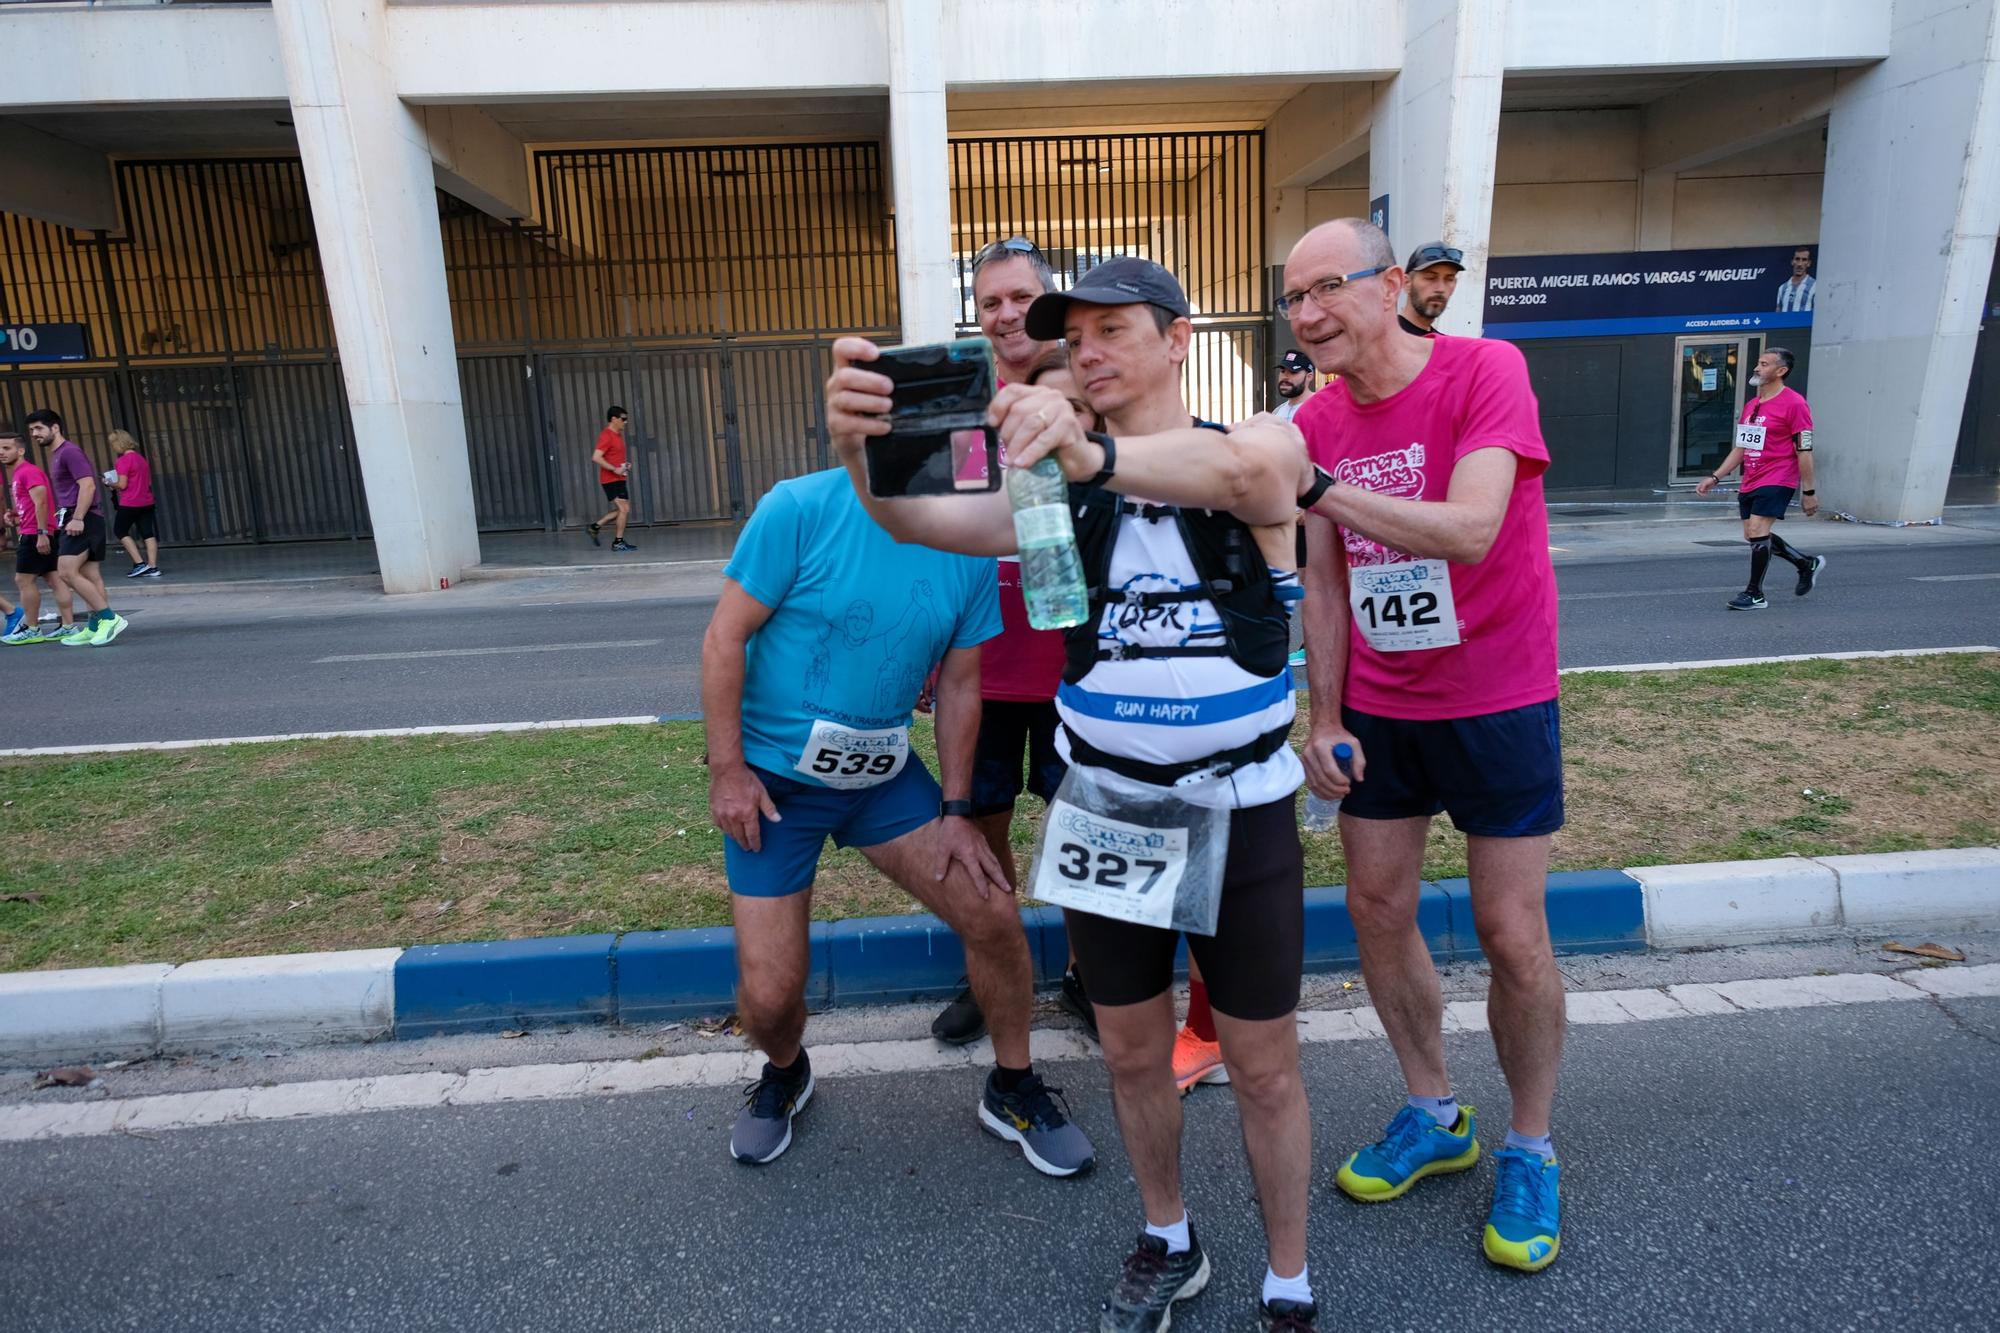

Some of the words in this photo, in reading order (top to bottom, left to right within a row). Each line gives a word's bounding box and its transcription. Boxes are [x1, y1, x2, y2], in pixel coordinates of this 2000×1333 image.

[1489, 276, 1538, 290] PUERTA
[1540, 273, 1590, 288] MIGUEL
[1592, 272, 1641, 286] RAMOS
[1643, 270, 1697, 284] VARGAS
[1489, 293, 1548, 306] 1942-2002
[1685, 320, 1709, 328] ACCESO
[1740, 432, 1761, 444] 138
[1360, 591, 1441, 629] 142
[1114, 700, 1146, 718] RUN
[1149, 703, 1200, 721] HAPPY
[812, 748, 897, 775] 539
[1058, 842, 1168, 895] 327
